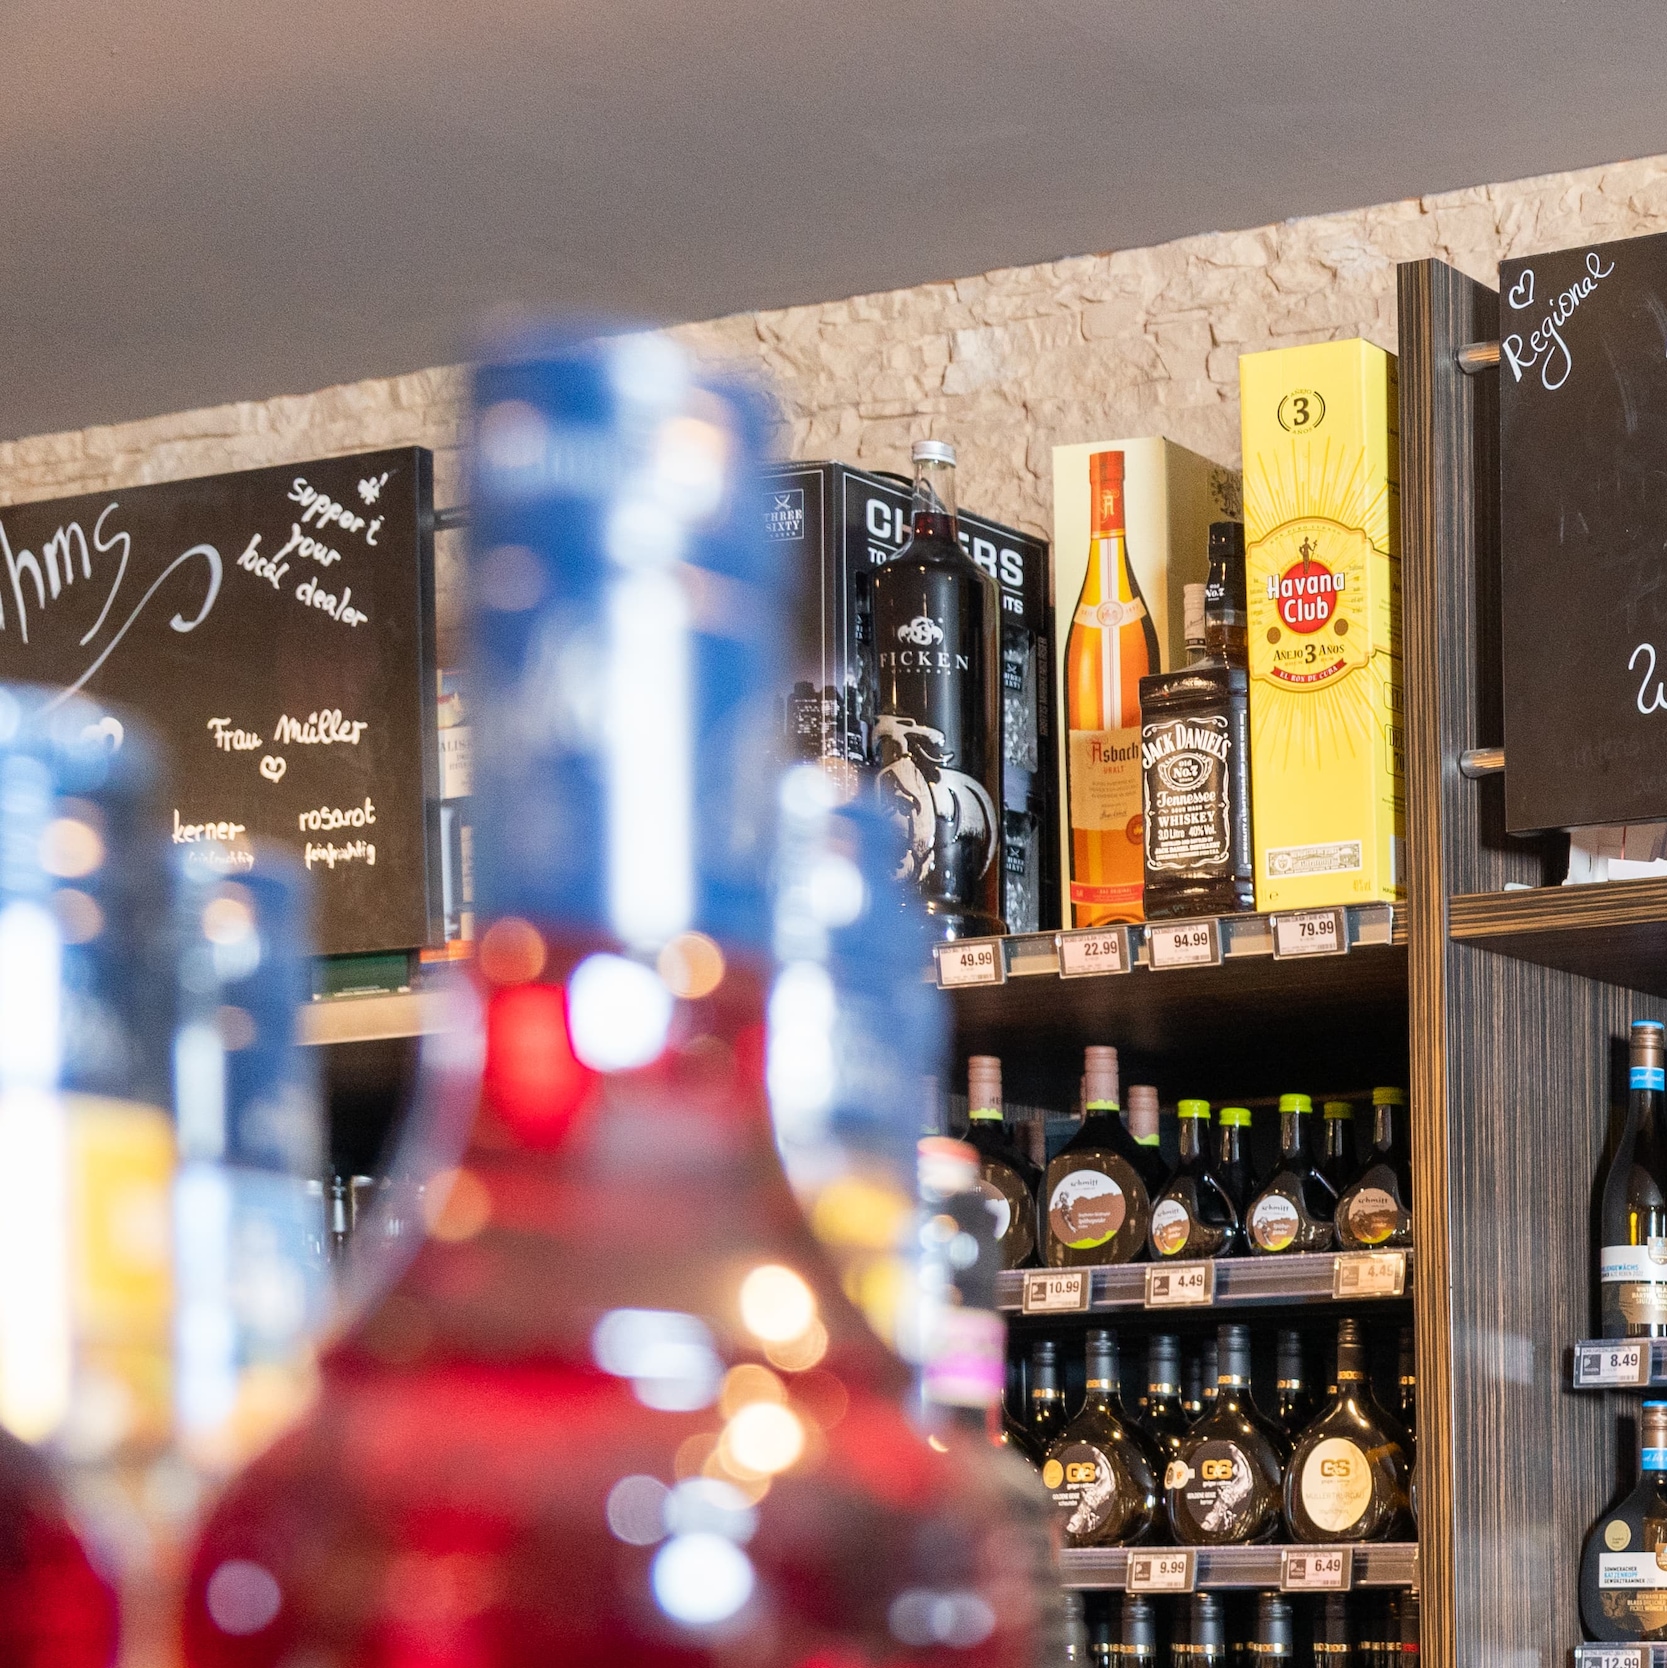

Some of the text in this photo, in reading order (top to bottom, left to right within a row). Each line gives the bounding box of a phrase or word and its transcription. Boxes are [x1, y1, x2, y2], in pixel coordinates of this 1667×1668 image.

[1502, 252, 1615, 391] Regional
[1293, 396, 1310, 426] 3
[288, 477, 386, 546] support
[763, 510, 802, 522] THREE
[765, 520, 800, 532] SIXTY
[272, 523, 341, 567] your
[0, 502, 130, 646] hms
[237, 533, 369, 628] local dealer
[1266, 571, 1346, 600] Havana
[1283, 596, 1329, 624] Club
[879, 650, 970, 670] FICKEN
[1273, 643, 1345, 664] AÑEJO 3 AÑOS
[1319, 665, 1338, 680] CUBA
[207, 709, 368, 751] Frau Müller
[1091, 740, 1139, 764] Asbach
[1142, 723, 1232, 769] JACK DANIEL'S
[1157, 791, 1216, 807] Tennessee
[299, 798, 376, 833] rosarot
[1158, 811, 1216, 827] WHISKEY
[1297, 919, 1335, 938] 79.99
[1083, 939, 1119, 958] 22.99
[1172, 930, 1209, 950] 94.99
[959, 951, 994, 968] 49.99
[1048, 1280, 1081, 1295] 10.99
[1159, 1560, 1185, 1575] 9.99
[1314, 1557, 1341, 1573] 6.49
